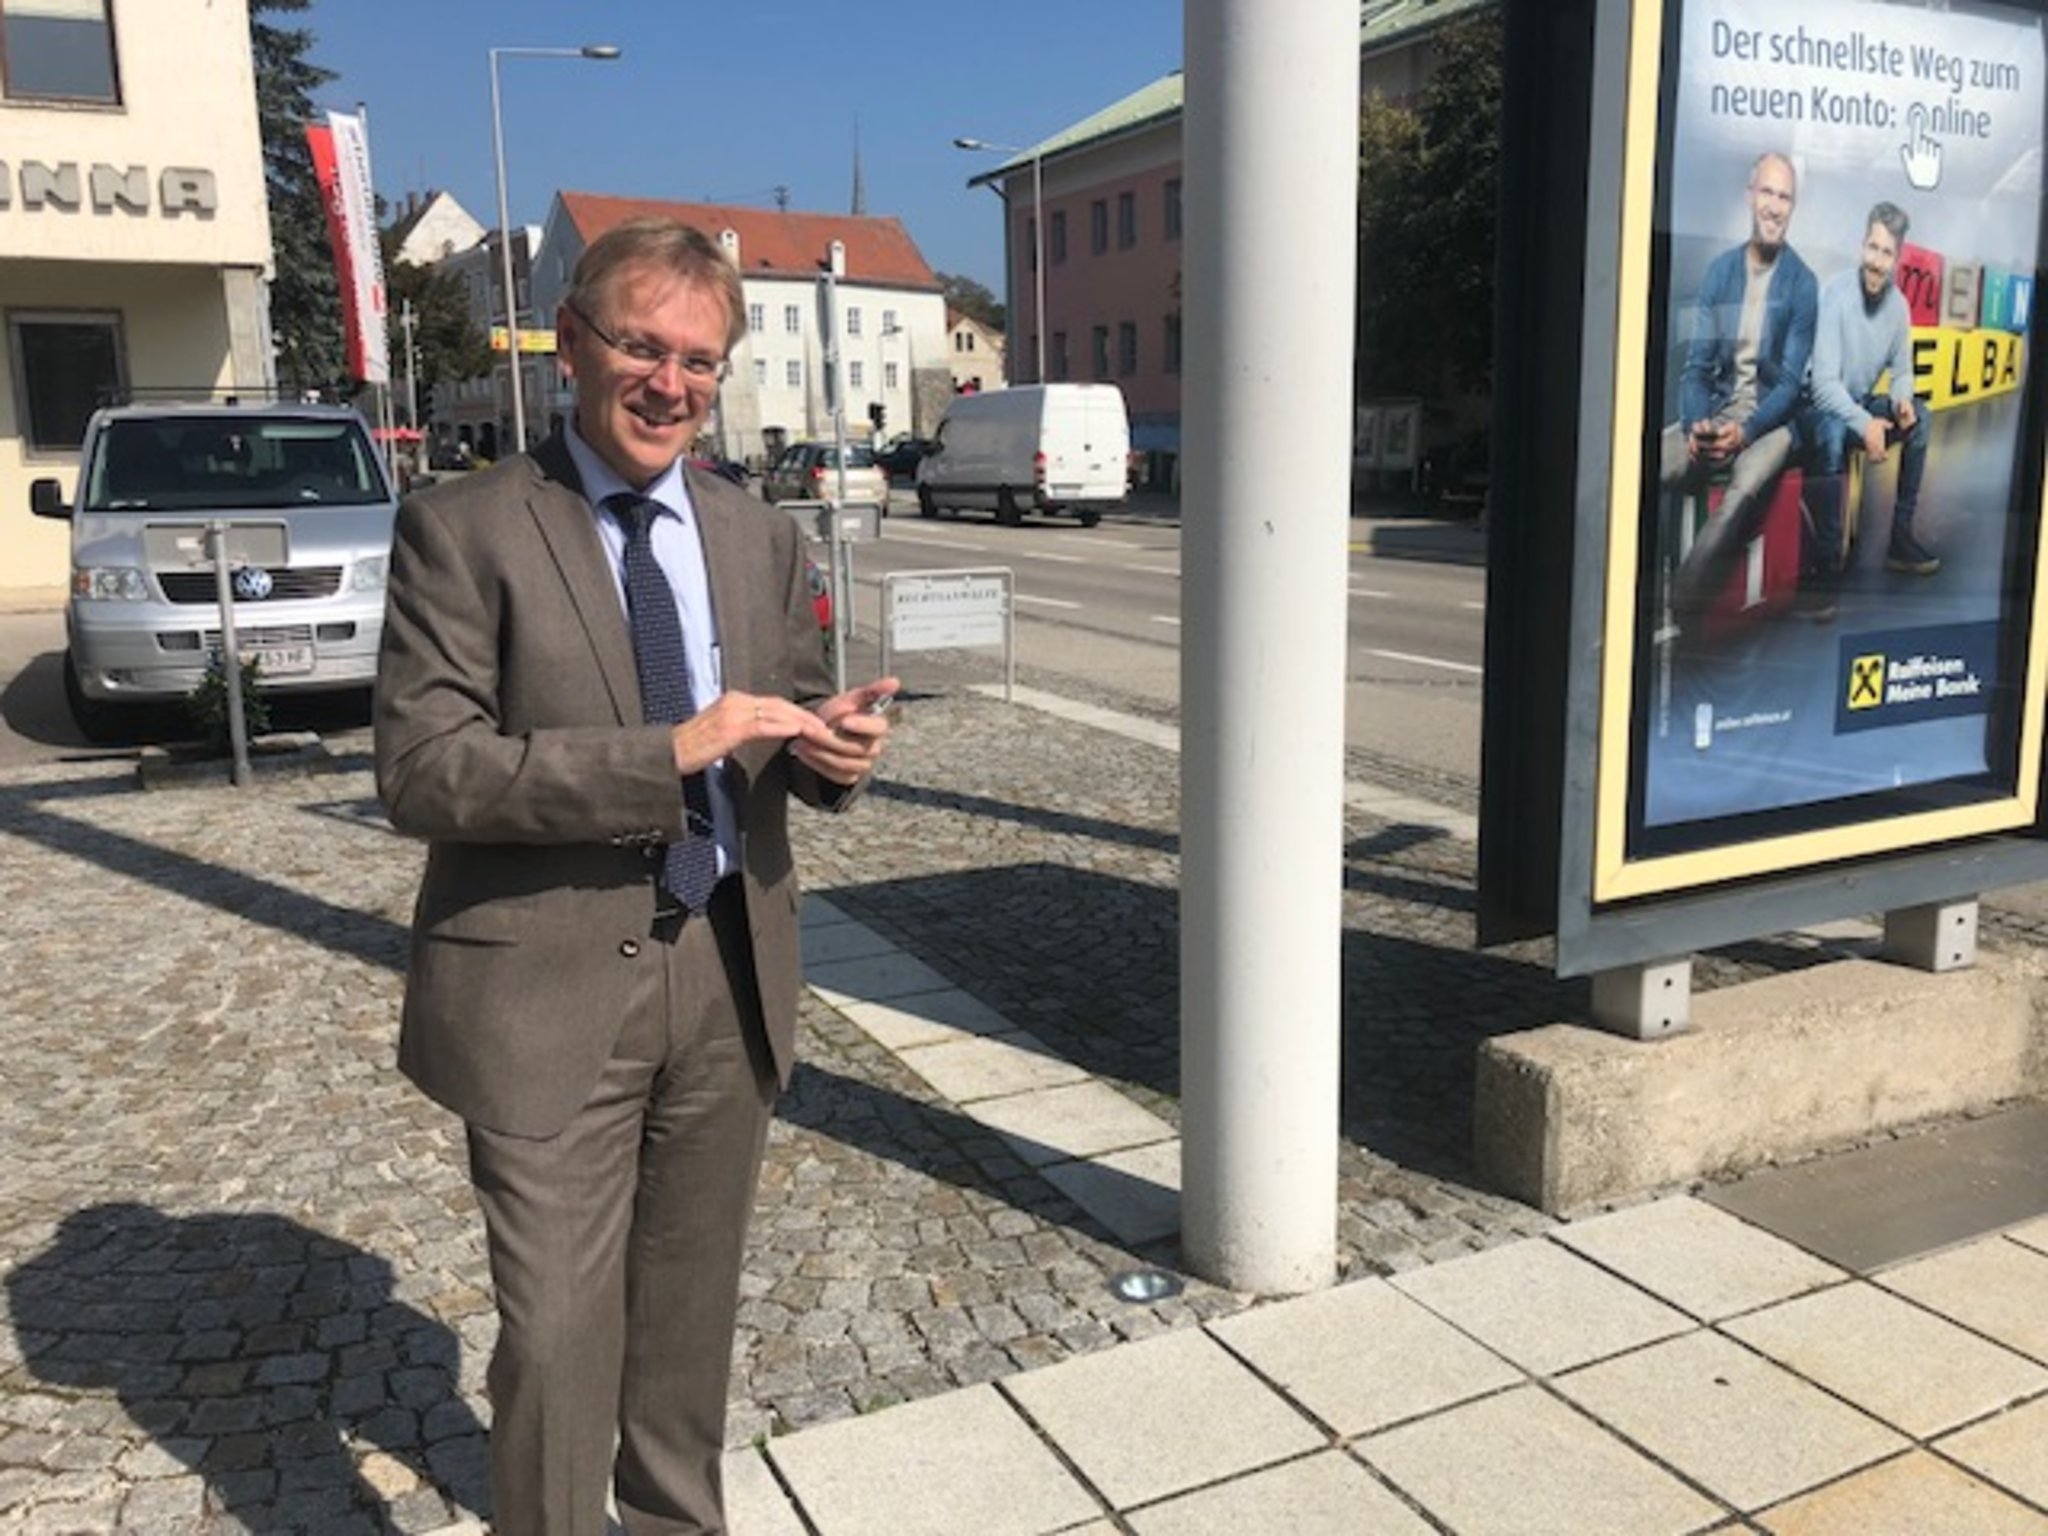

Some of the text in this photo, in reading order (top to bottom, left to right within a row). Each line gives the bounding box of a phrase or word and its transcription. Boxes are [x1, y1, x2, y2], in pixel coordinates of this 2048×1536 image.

[1711, 20, 2021, 93] Der schnellste Weg zum
[1711, 83, 1803, 120] neuen
[1811, 87, 1897, 129] Konto:
[0, 160, 217, 220] NNA
[1913, 338, 2017, 401] ELBA
[1886, 673, 1981, 703] Meine Bank
[1888, 655, 1966, 681] Raiffeisen
